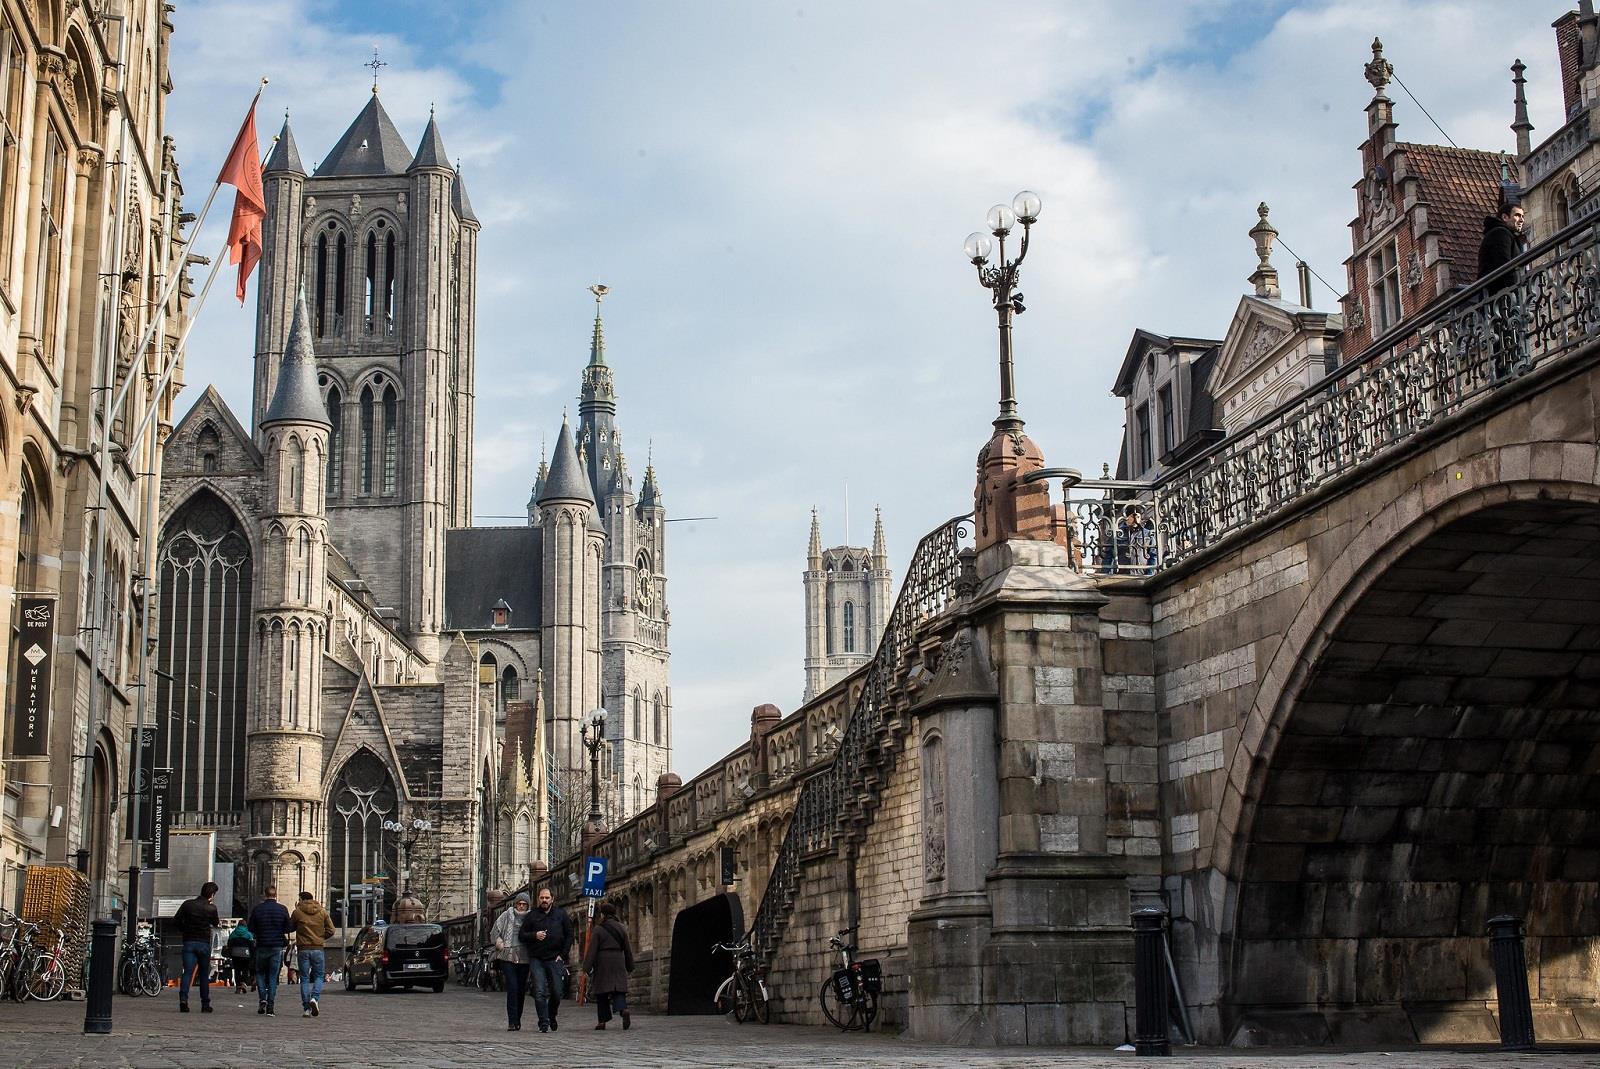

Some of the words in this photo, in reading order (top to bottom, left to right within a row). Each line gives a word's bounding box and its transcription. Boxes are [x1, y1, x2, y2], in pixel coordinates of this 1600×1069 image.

[156, 795, 163, 805] LE
[154, 823, 162, 863] QUOTIDIEN
[588, 862, 604, 882] P
[584, 888, 602, 896] TAXI
